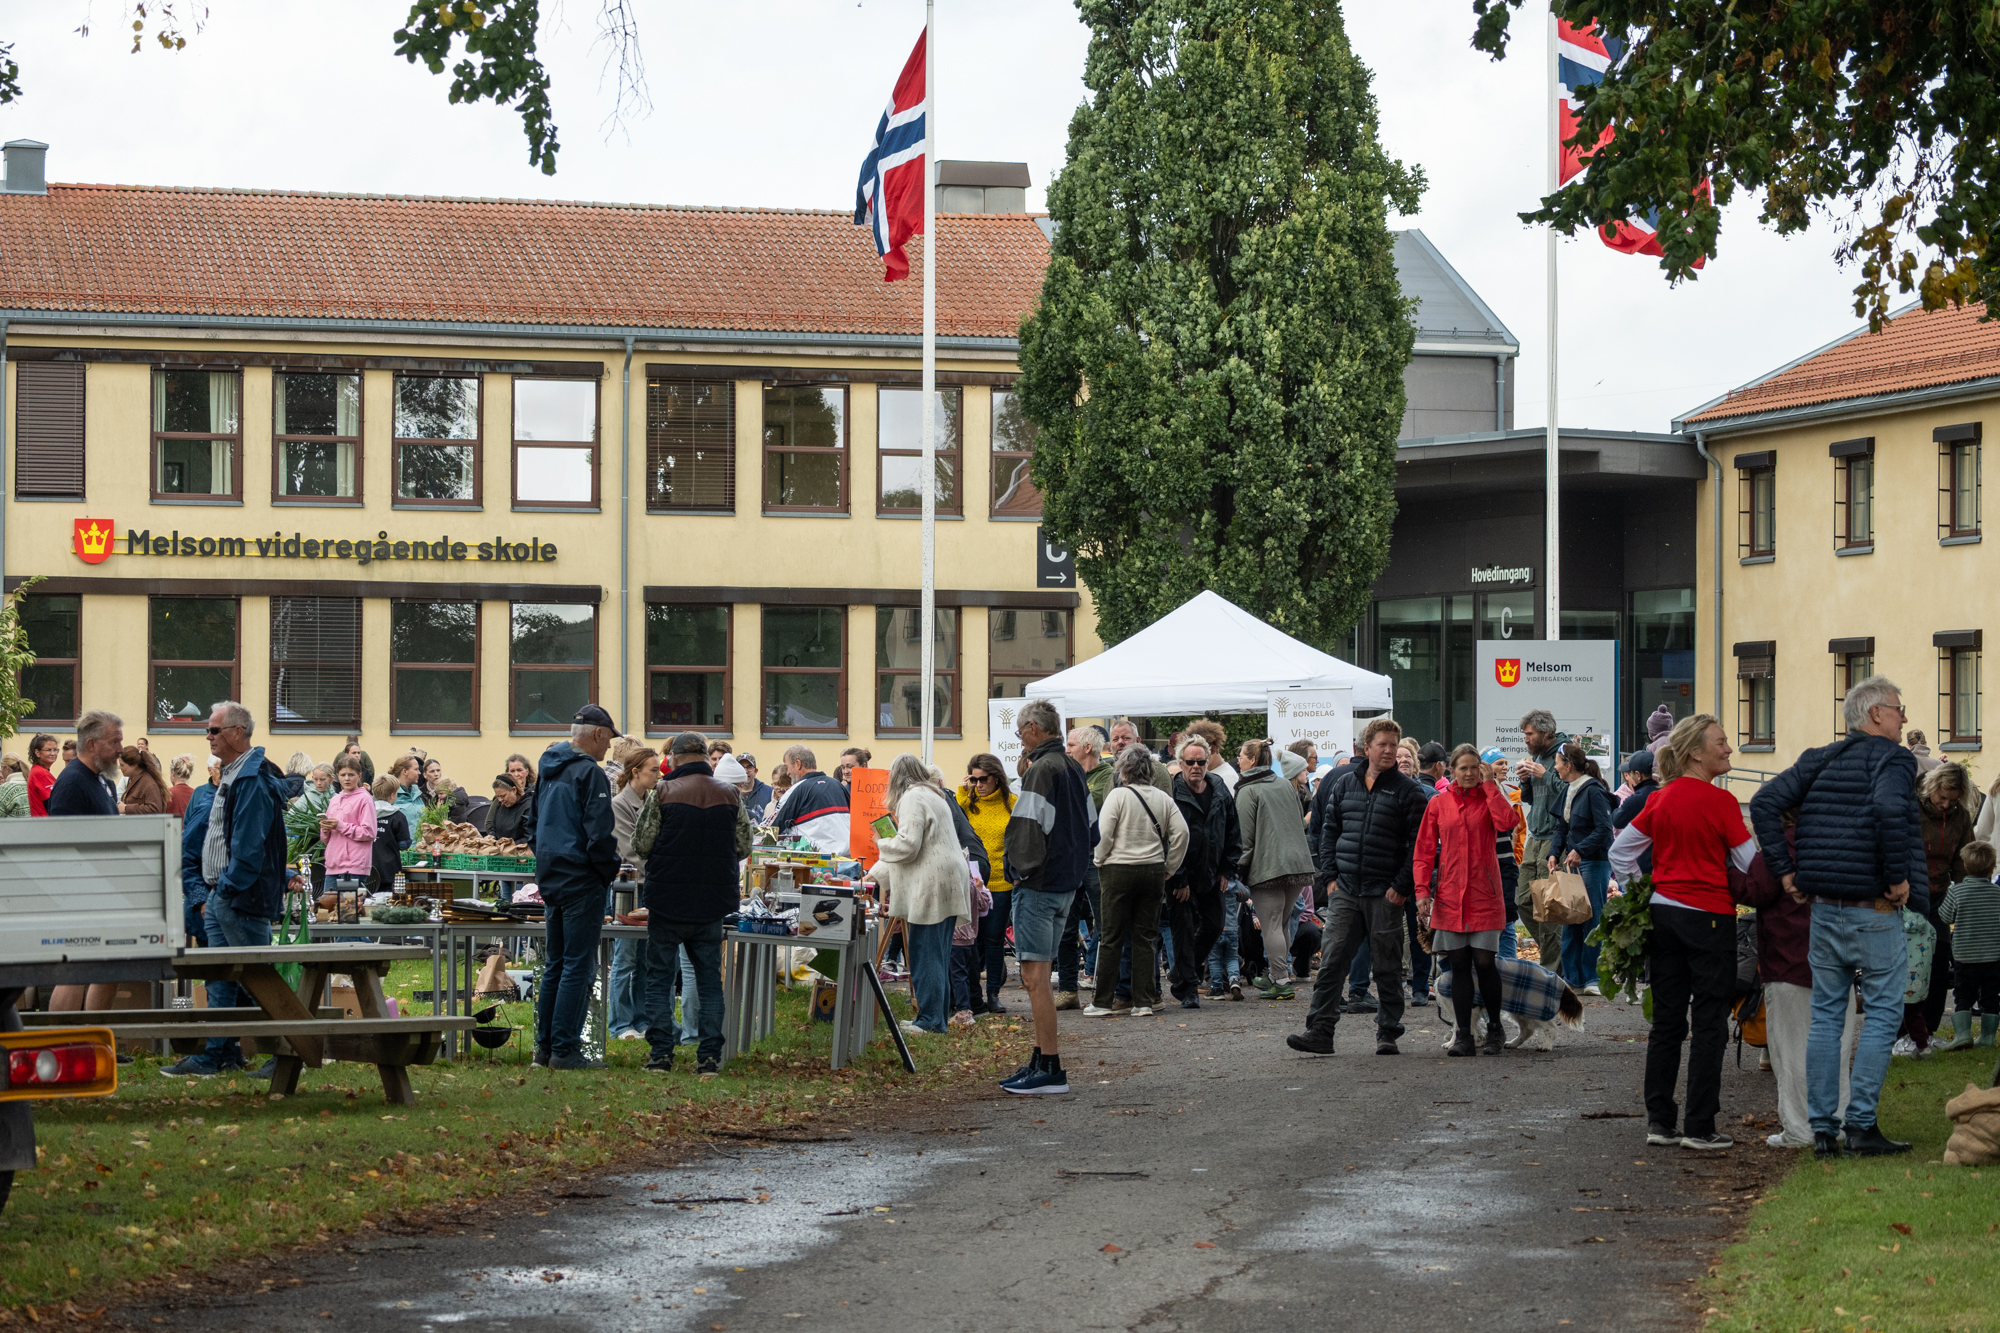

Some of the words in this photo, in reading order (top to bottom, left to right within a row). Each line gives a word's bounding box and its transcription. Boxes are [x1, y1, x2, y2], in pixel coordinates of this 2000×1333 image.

[128, 529, 246, 557] Melsom
[255, 531, 468, 566] videregående
[477, 536, 558, 562] skole
[1471, 565, 1530, 584] Hovedinngang
[1501, 606, 1513, 639] C
[1526, 661, 1572, 672] Melsom
[1292, 701, 1332, 709] VESTFOLD
[1292, 710, 1335, 718] BONDELAG
[1290, 728, 1301, 738] Vi
[1303, 728, 1330, 740] lager
[1320, 741, 1337, 750] din
[41, 936, 102, 946] BLUEMOTION
